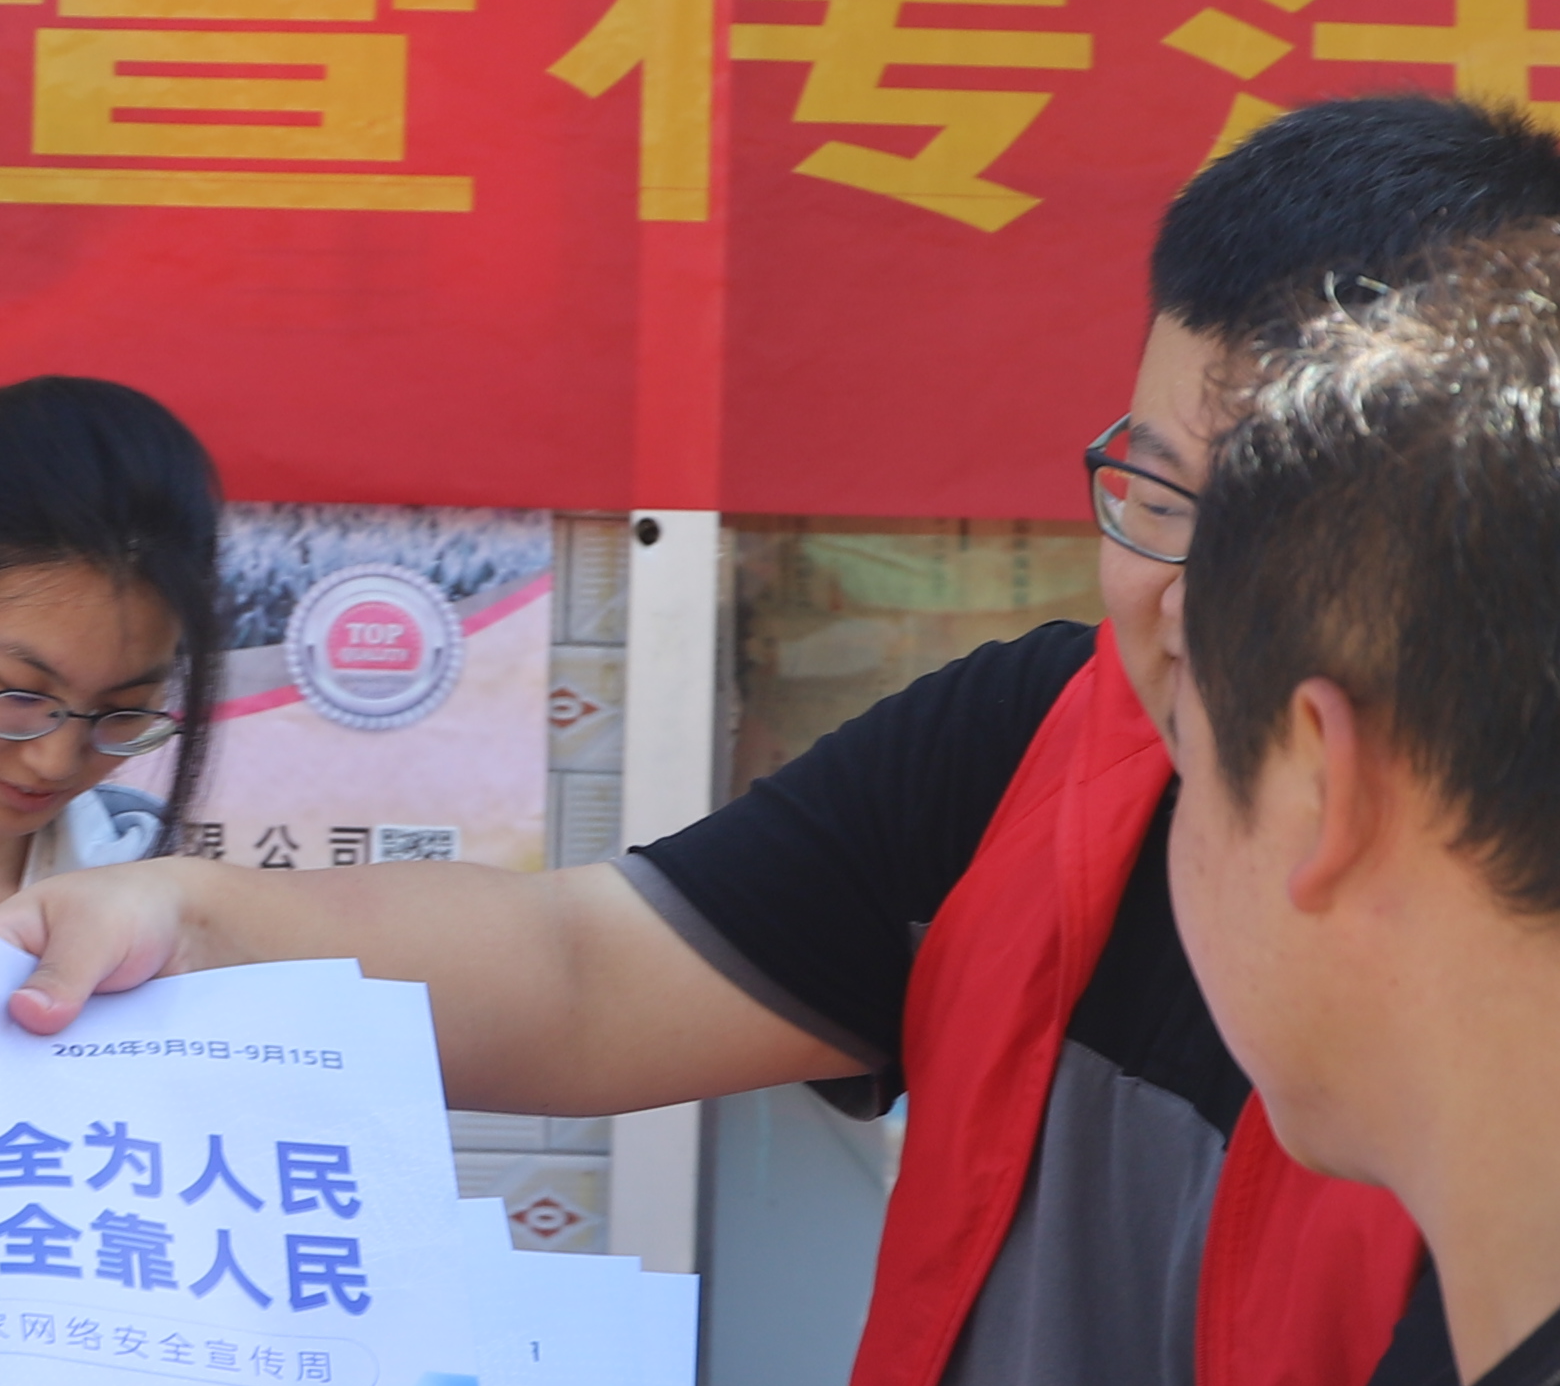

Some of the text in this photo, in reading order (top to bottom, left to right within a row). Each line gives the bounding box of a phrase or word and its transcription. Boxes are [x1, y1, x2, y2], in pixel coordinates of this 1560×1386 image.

[345, 622, 405, 645] TOP
[51, 1038, 345, 1071] 2024年9月9日-9月15日
